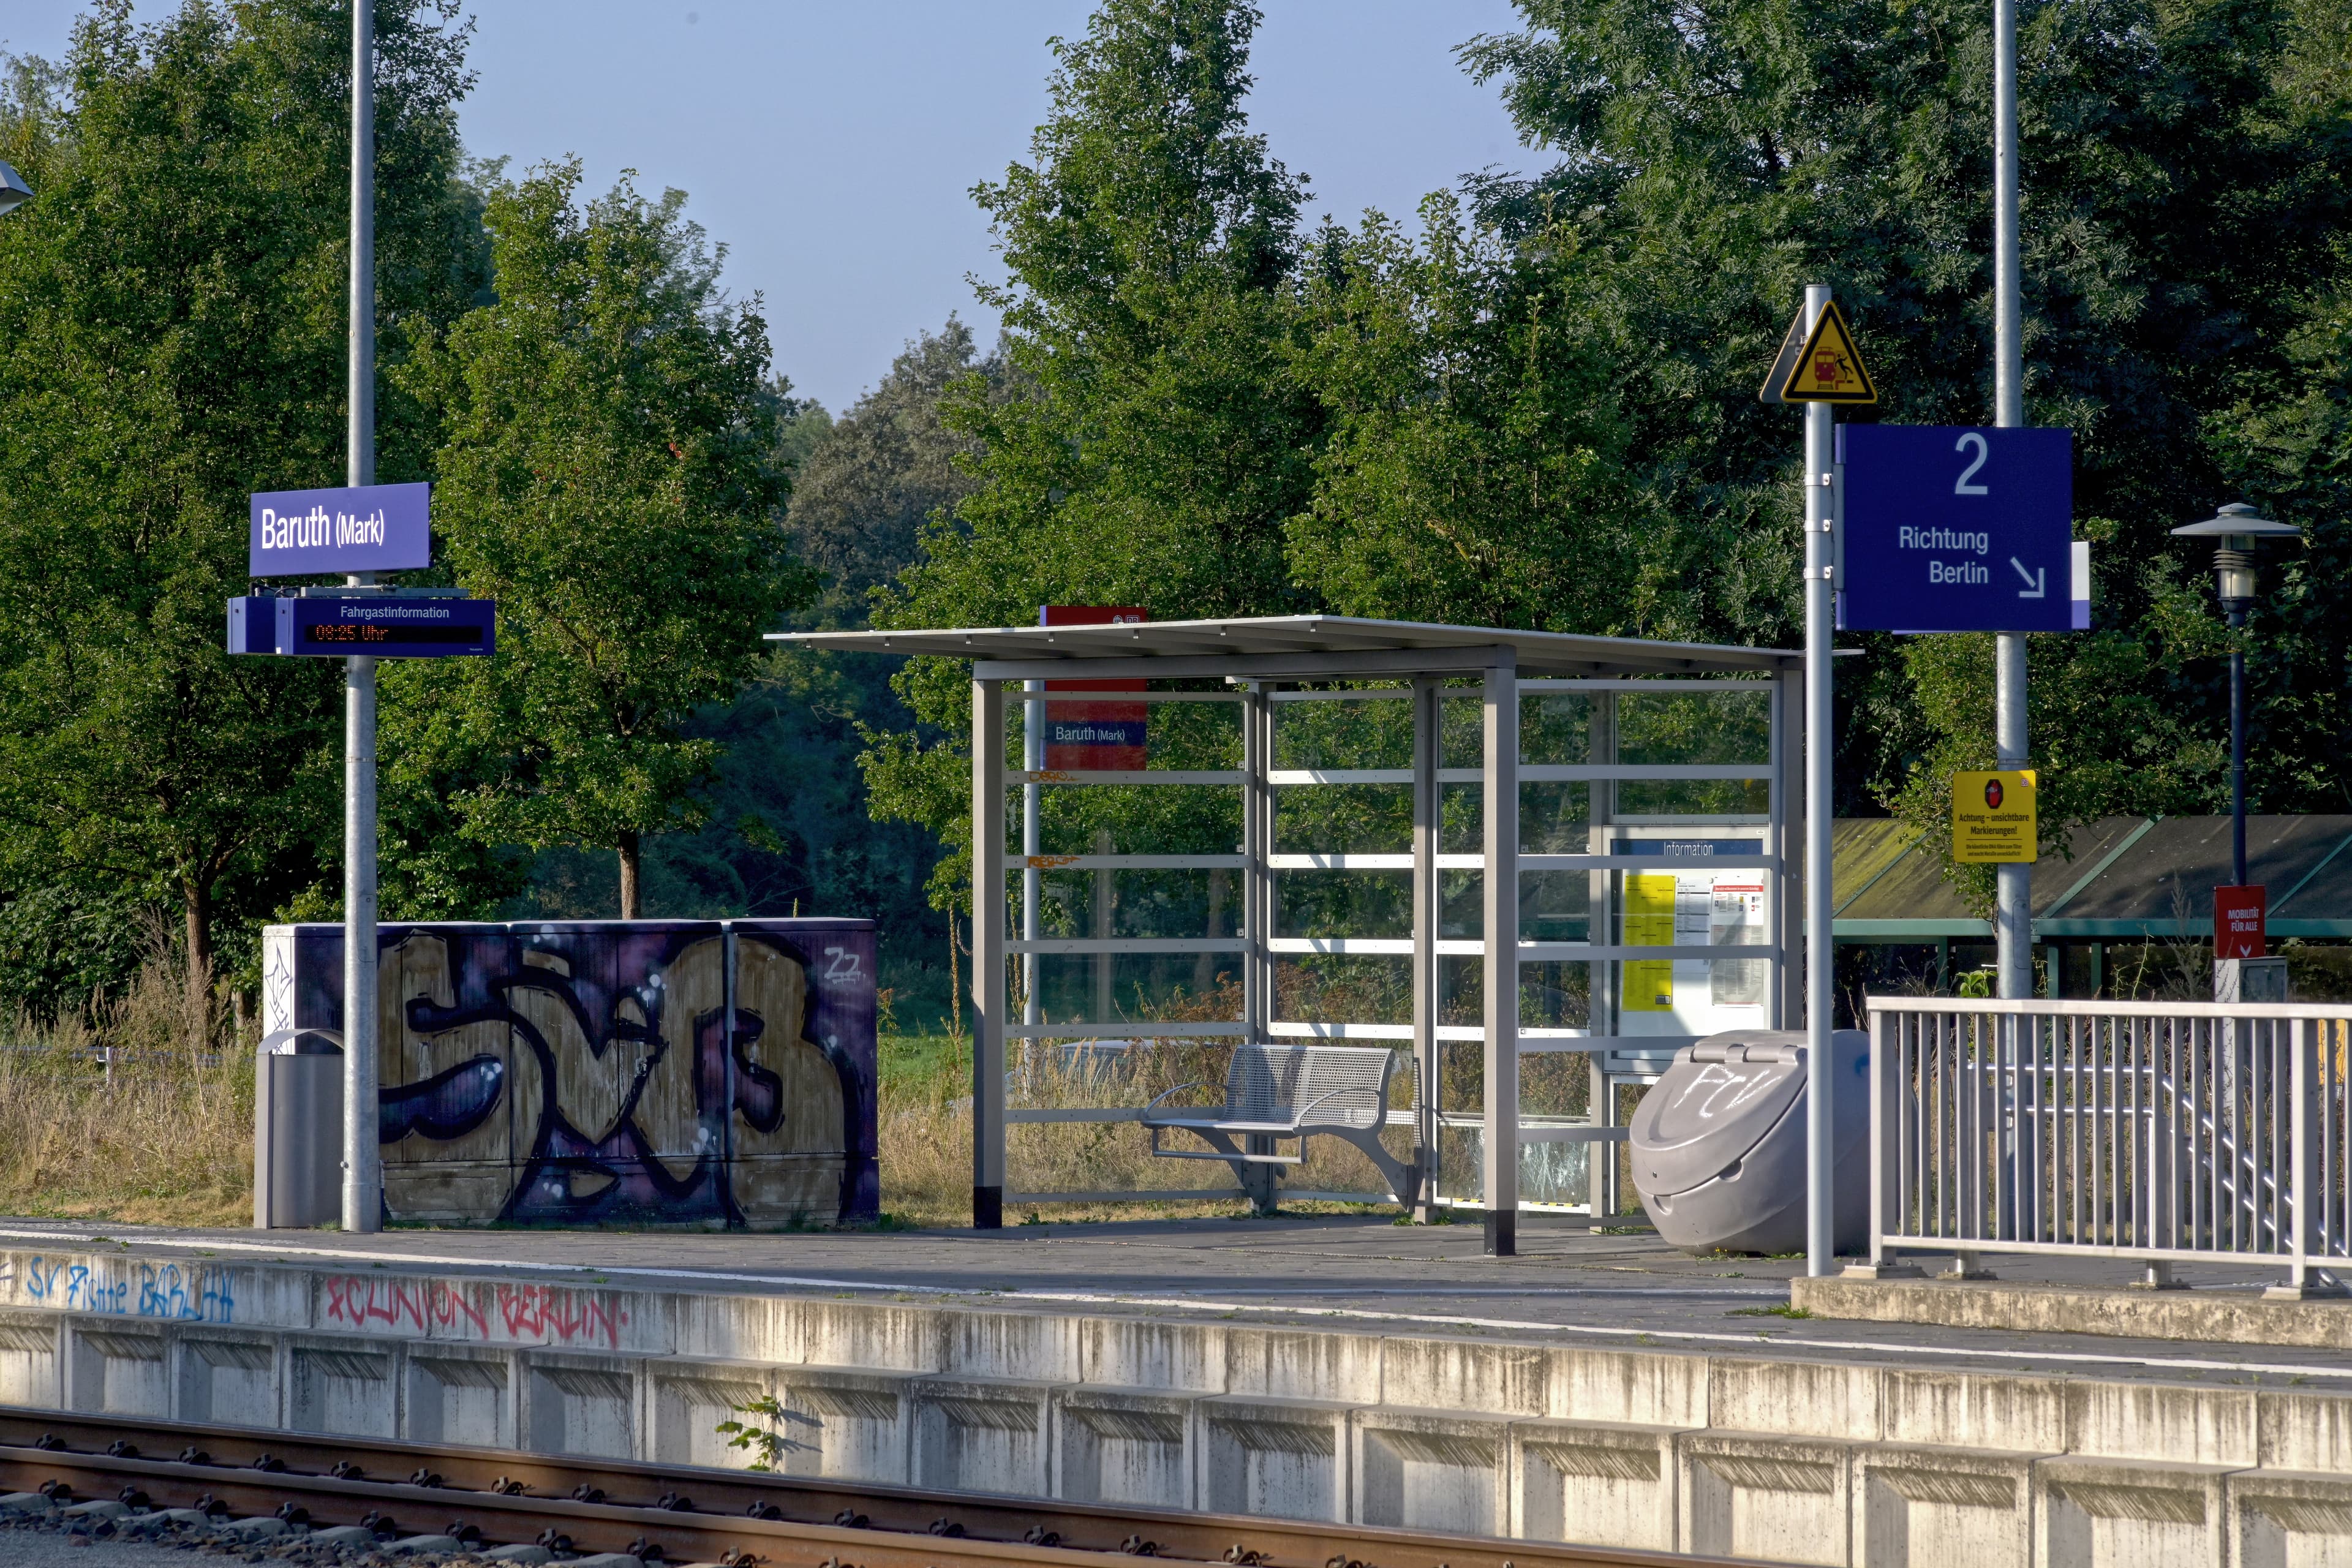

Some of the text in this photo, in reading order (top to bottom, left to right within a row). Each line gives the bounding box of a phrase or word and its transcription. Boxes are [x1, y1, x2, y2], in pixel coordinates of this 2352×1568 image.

[1955, 432, 1988, 495] 2
[262, 505, 385, 549] Baruth (Mark)
[1899, 526, 1989, 555] Richtung
[1929, 561, 1989, 584] Berlin
[340, 605, 450, 620] Fahrgastinformation
[362, 625, 389, 641] Uhr
[1055, 726, 1125, 742] Baruth (Mark)
[1959, 813, 1985, 824] Achtung
[1991, 813, 2029, 821] unsichtbare
[1970, 825, 2018, 837] Markierungen!
[1664, 841, 1713, 856] Information
[2228, 907, 2260, 919] MOBILITÄT
[2231, 920, 2258, 932] FÜR ALLE
[28, 1256, 61, 1300] SV
